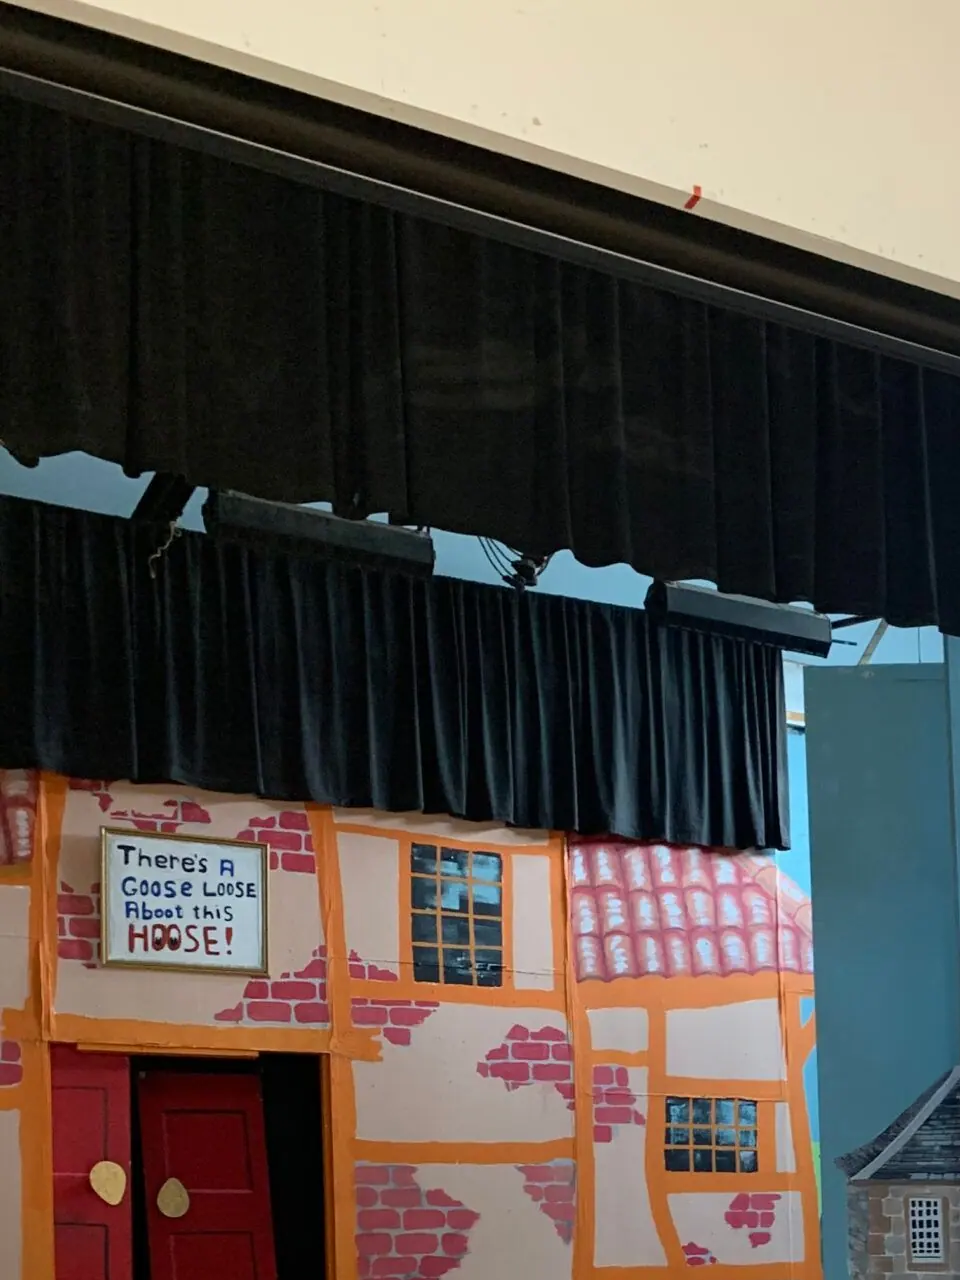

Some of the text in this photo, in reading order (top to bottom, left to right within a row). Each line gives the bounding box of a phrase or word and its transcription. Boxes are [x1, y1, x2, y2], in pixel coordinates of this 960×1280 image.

[117, 845, 234, 877] There's A
[125, 901, 183, 920] Aboot
[128, 923, 233, 955] HOOSE!
